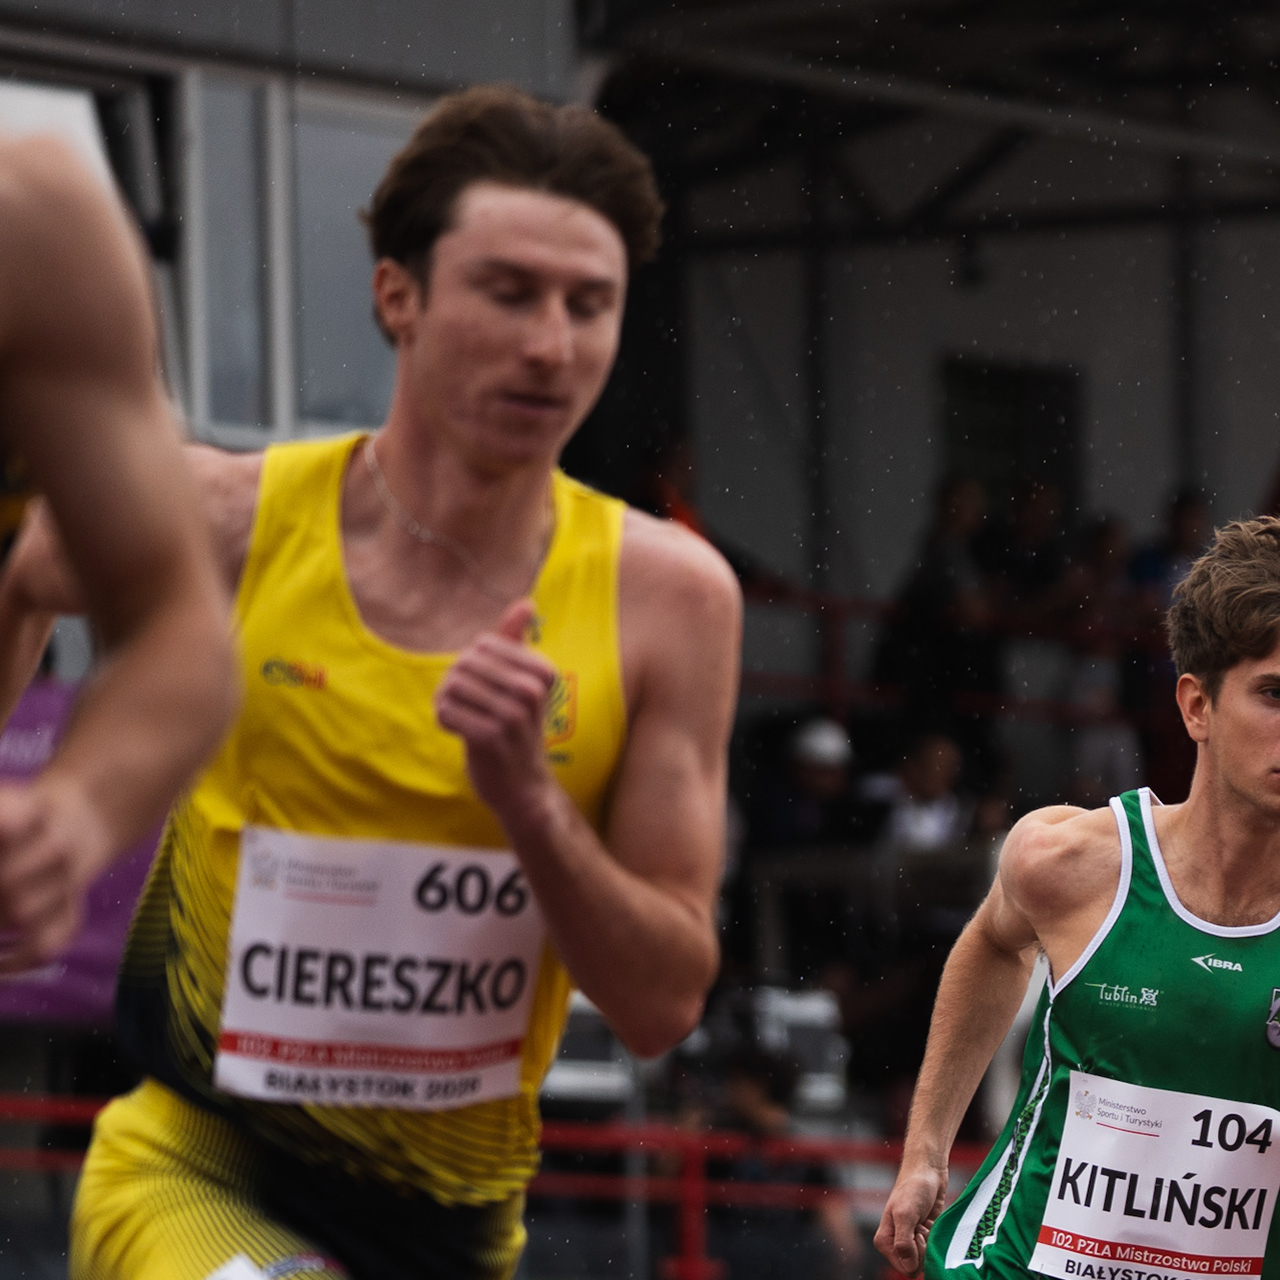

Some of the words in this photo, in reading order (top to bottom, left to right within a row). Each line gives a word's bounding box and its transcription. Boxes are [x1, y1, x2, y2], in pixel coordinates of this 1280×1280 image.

[414, 862, 528, 916] 606
[240, 942, 528, 1016] CIERESZKO
[1097, 1107, 1118, 1121] Sportu
[1125, 1114, 1163, 1128] Turystyki
[1098, 1097, 1147, 1115] Ministerstwo
[1191, 1108, 1274, 1154] 104
[1057, 1157, 1268, 1230] KITLIŃSKI
[1051, 1231, 1074, 1250] 102.
[1077, 1239, 1112, 1258] PZLA
[1116, 1246, 1210, 1272] Mistrzostwa
[1213, 1259, 1252, 1273] Polski
